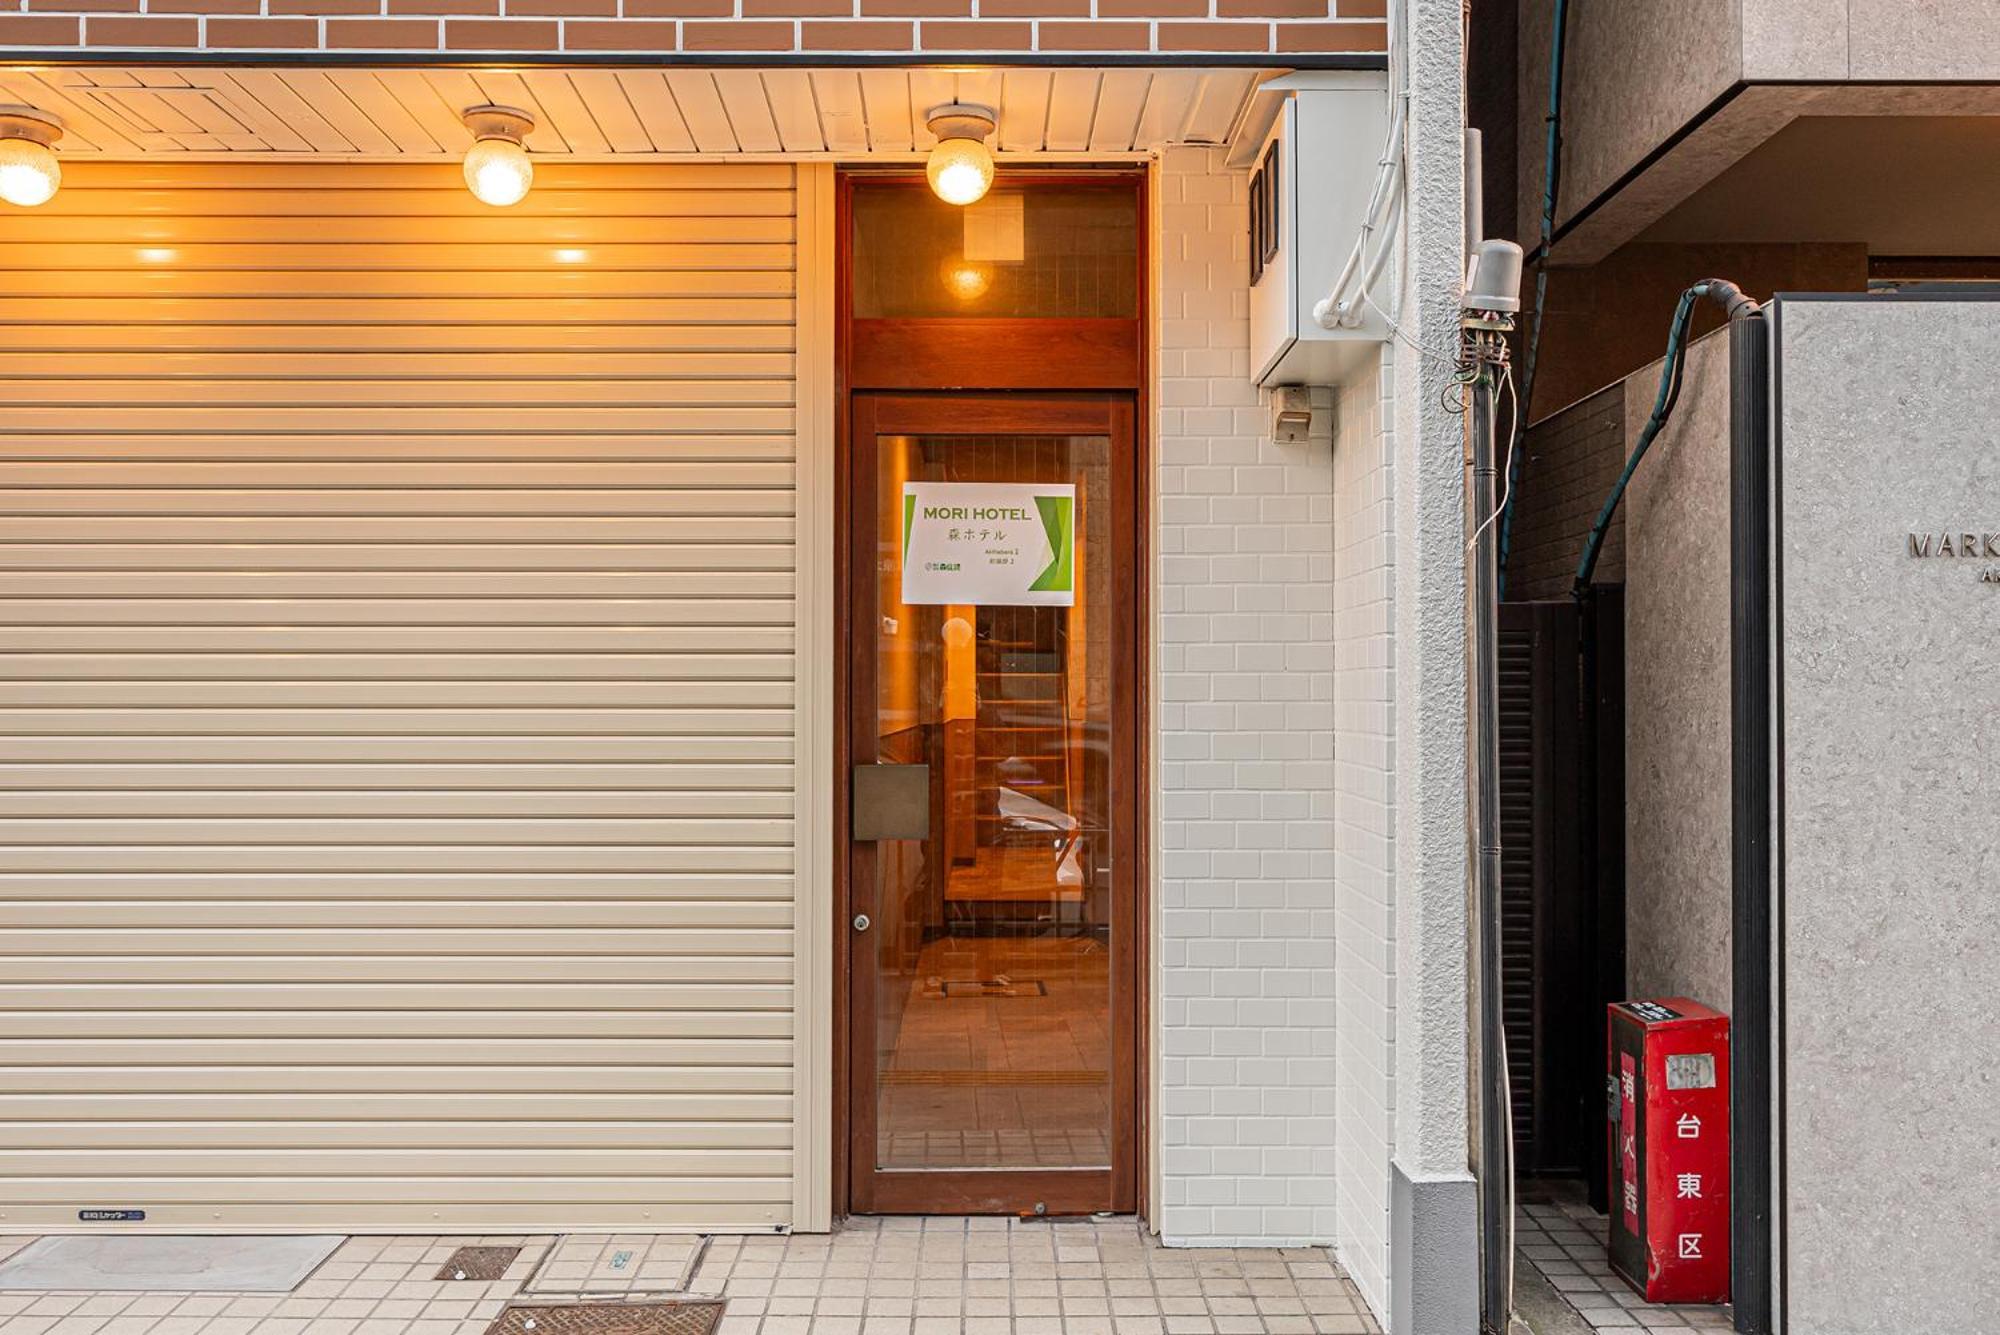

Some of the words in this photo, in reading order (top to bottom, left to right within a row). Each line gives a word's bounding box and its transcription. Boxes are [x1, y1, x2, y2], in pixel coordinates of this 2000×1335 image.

[923, 507, 968, 520] MORI
[973, 508, 1032, 521] HOTEL
[948, 528, 1007, 541] 森ホテル
[1676, 1112, 1703, 1259] 台東区
